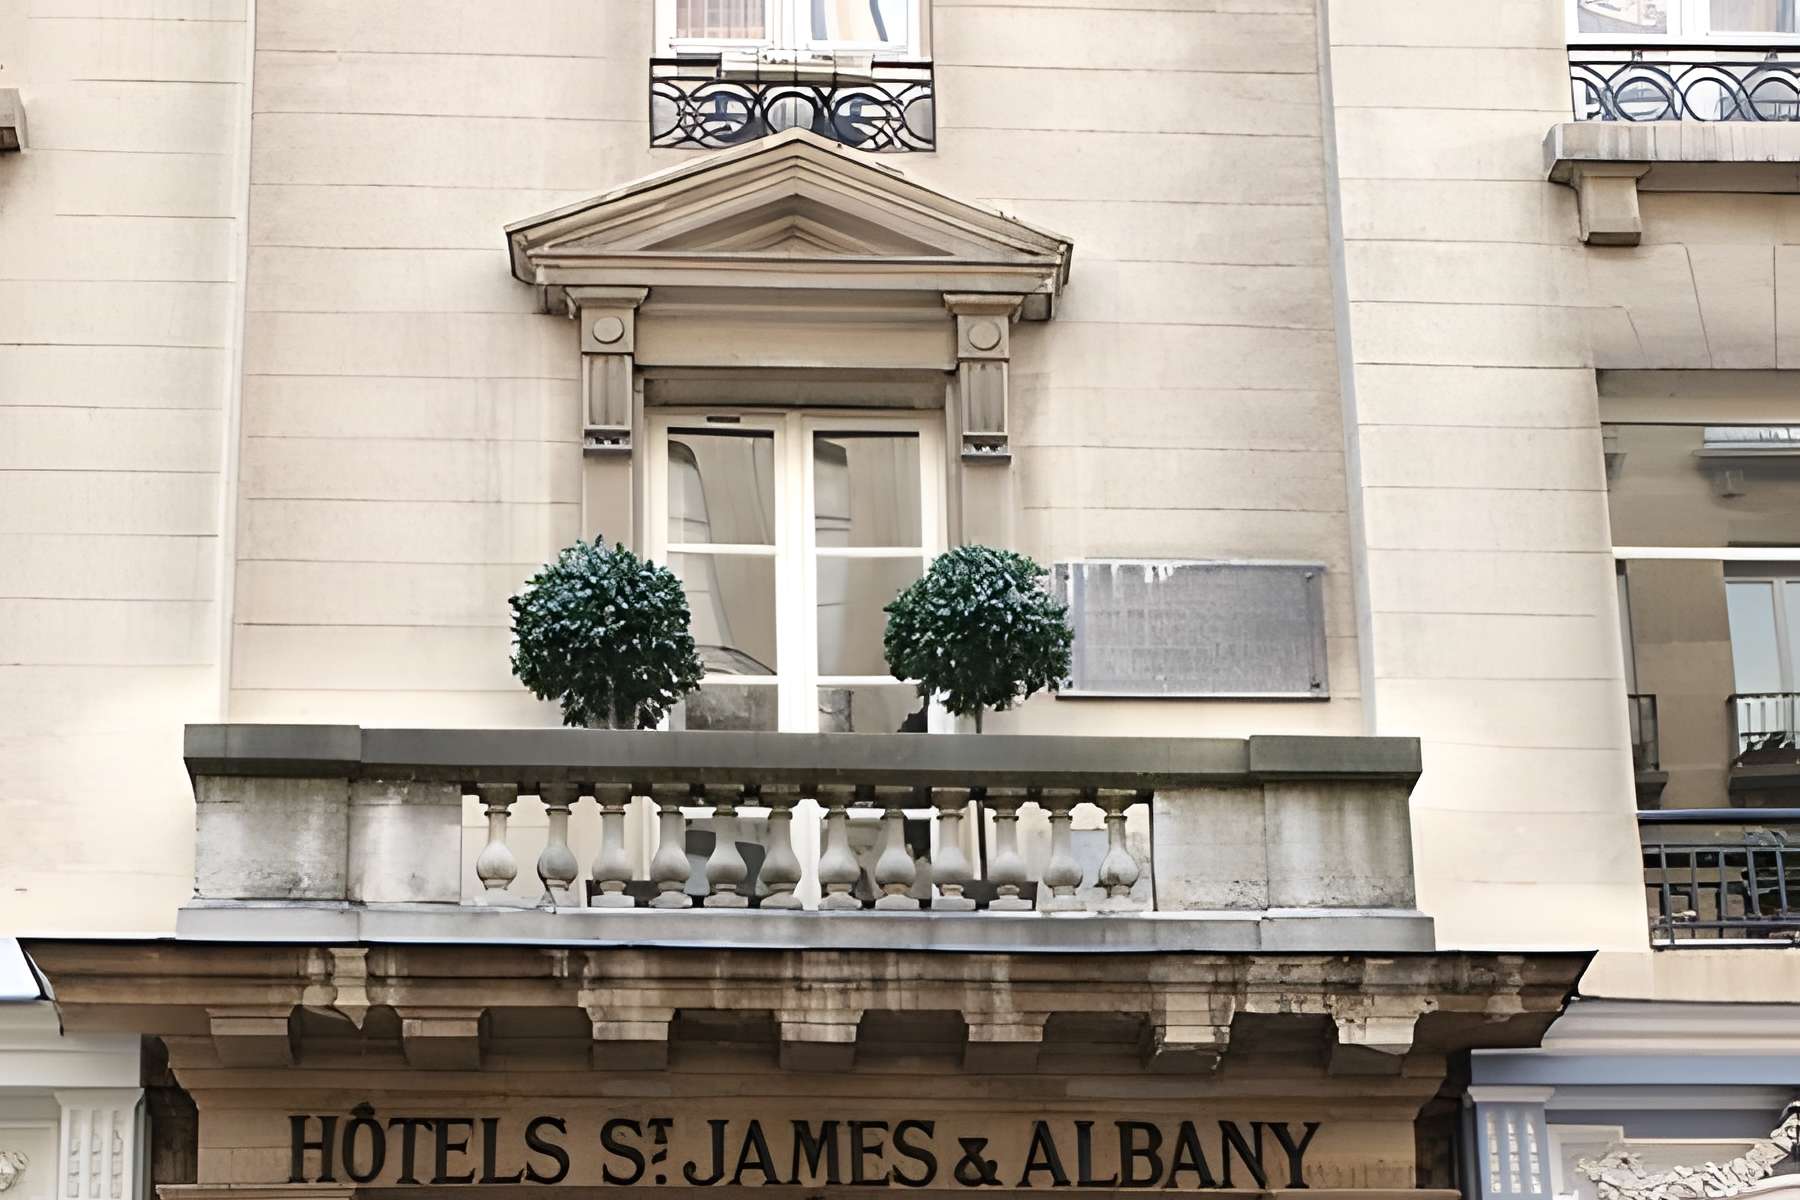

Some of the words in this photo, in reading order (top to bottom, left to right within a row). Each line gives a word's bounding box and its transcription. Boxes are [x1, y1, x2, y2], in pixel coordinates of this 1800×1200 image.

[289, 1103, 569, 1184] HÔTELS
[683, 1119, 938, 1187] JAMES
[953, 1137, 1002, 1187] &
[1016, 1120, 1321, 1189] ALBANY
